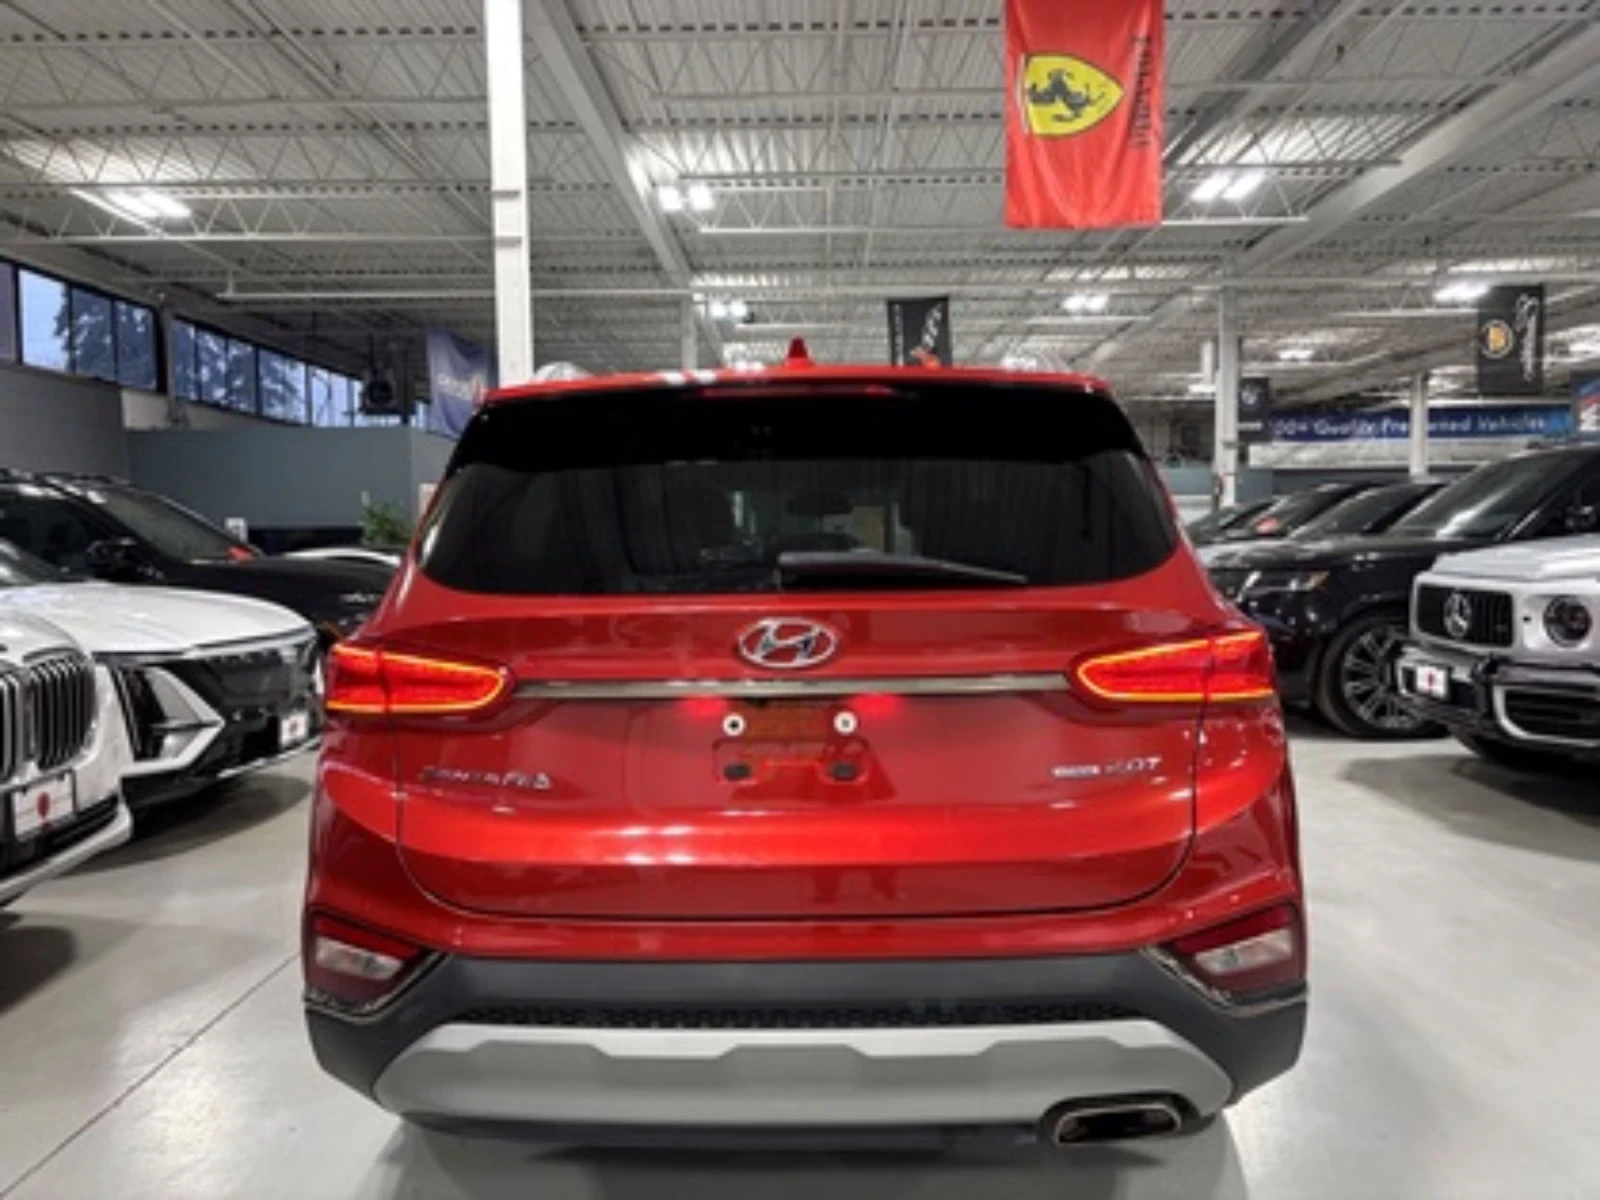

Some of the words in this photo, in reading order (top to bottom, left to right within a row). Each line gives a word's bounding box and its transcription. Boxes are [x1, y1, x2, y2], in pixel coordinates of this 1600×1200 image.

[1268, 417, 1307, 437] 00+
[1313, 418, 1377, 438] Quality
[1477, 414, 1547, 433] Vehicles
